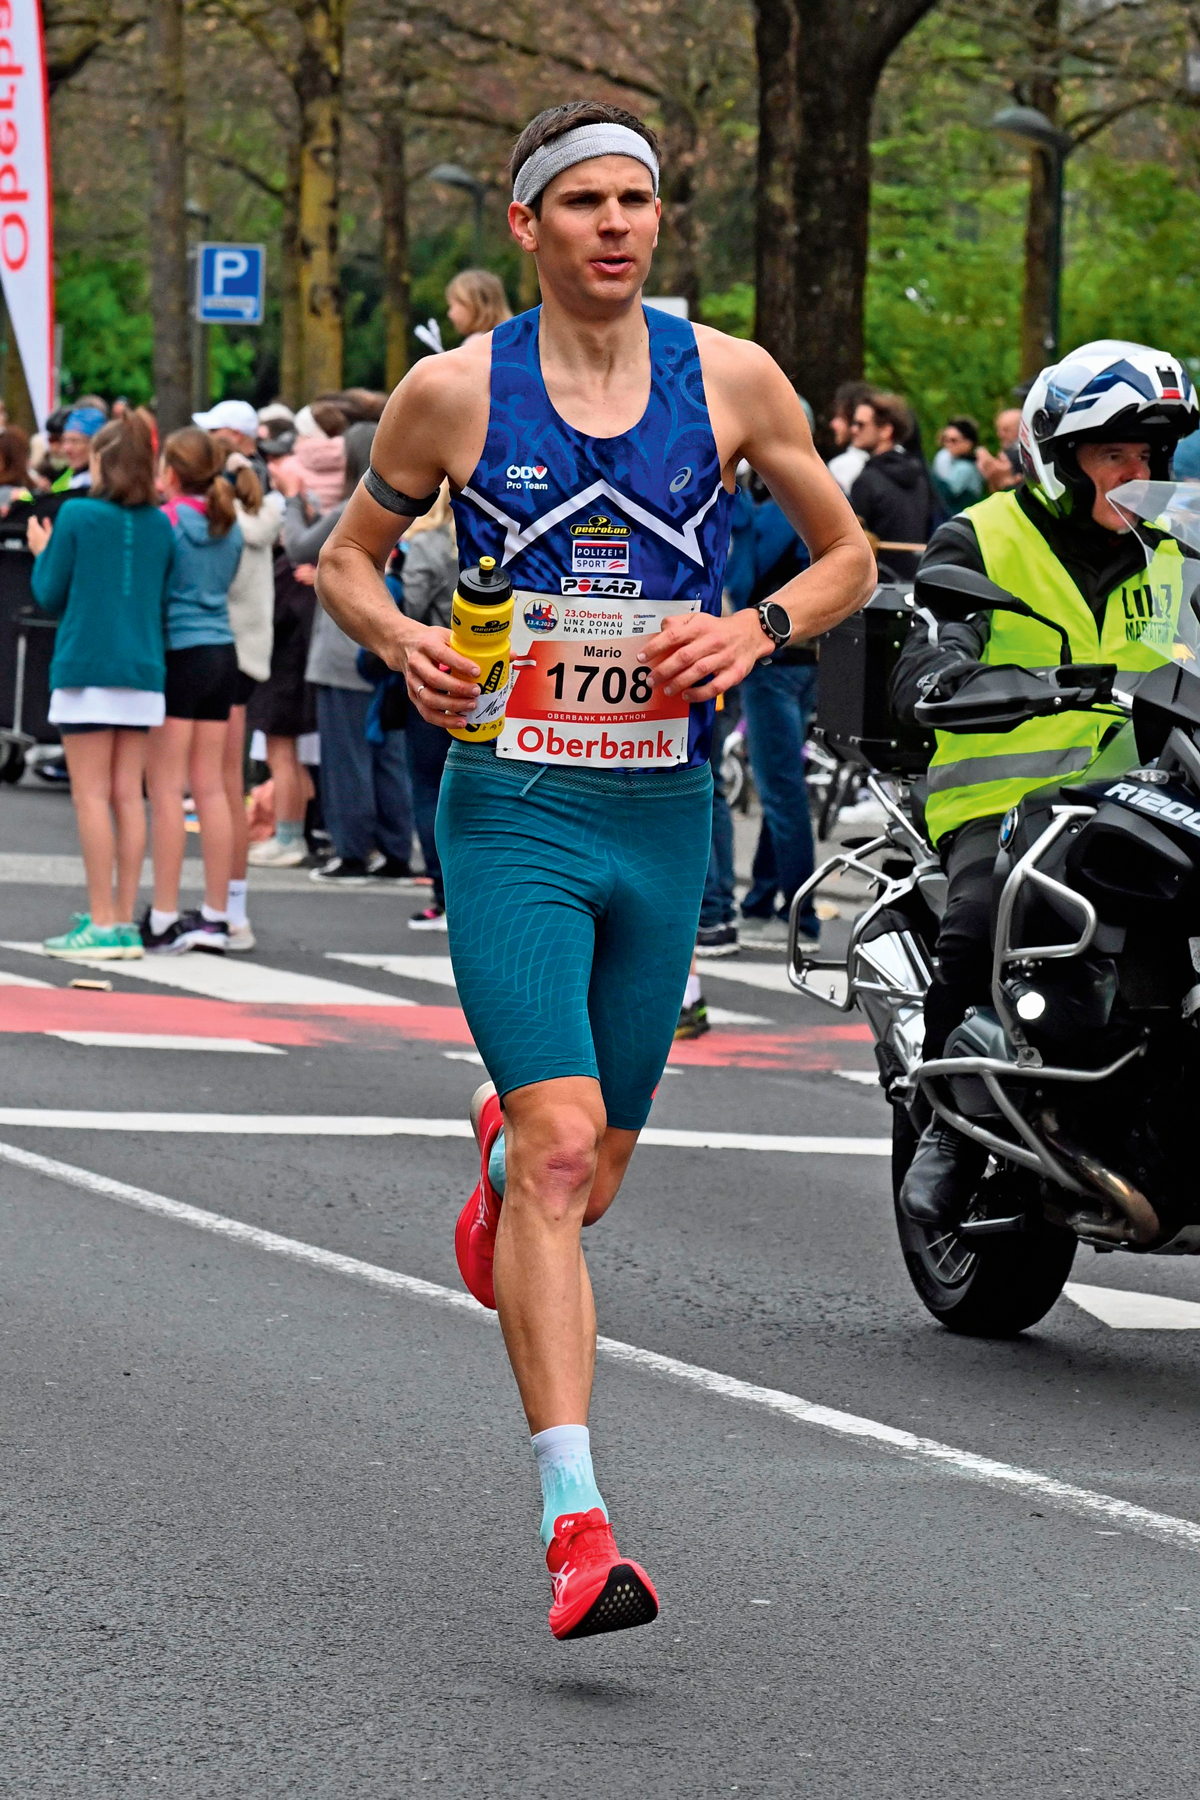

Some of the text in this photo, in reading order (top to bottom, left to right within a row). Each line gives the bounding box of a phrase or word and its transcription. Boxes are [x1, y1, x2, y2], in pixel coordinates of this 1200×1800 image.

[213, 251, 249, 293] P
[506, 481, 548, 490] Pro Team
[574, 526, 628, 535] peeroton
[577, 548, 617, 557] POLIZEI
[576, 560, 606, 568] SPORT
[565, 609, 623, 620] 23.Oberbank
[526, 619, 555, 628] 13.4.2025
[564, 618, 623, 628] LINZ DONAU
[563, 626, 623, 636] MARATHON
[583, 645, 622, 658] Mario
[547, 662, 653, 705] 1708
[547, 712, 646, 722] OBERBANK MARATHON
[517, 726, 673, 760] Oberbank
